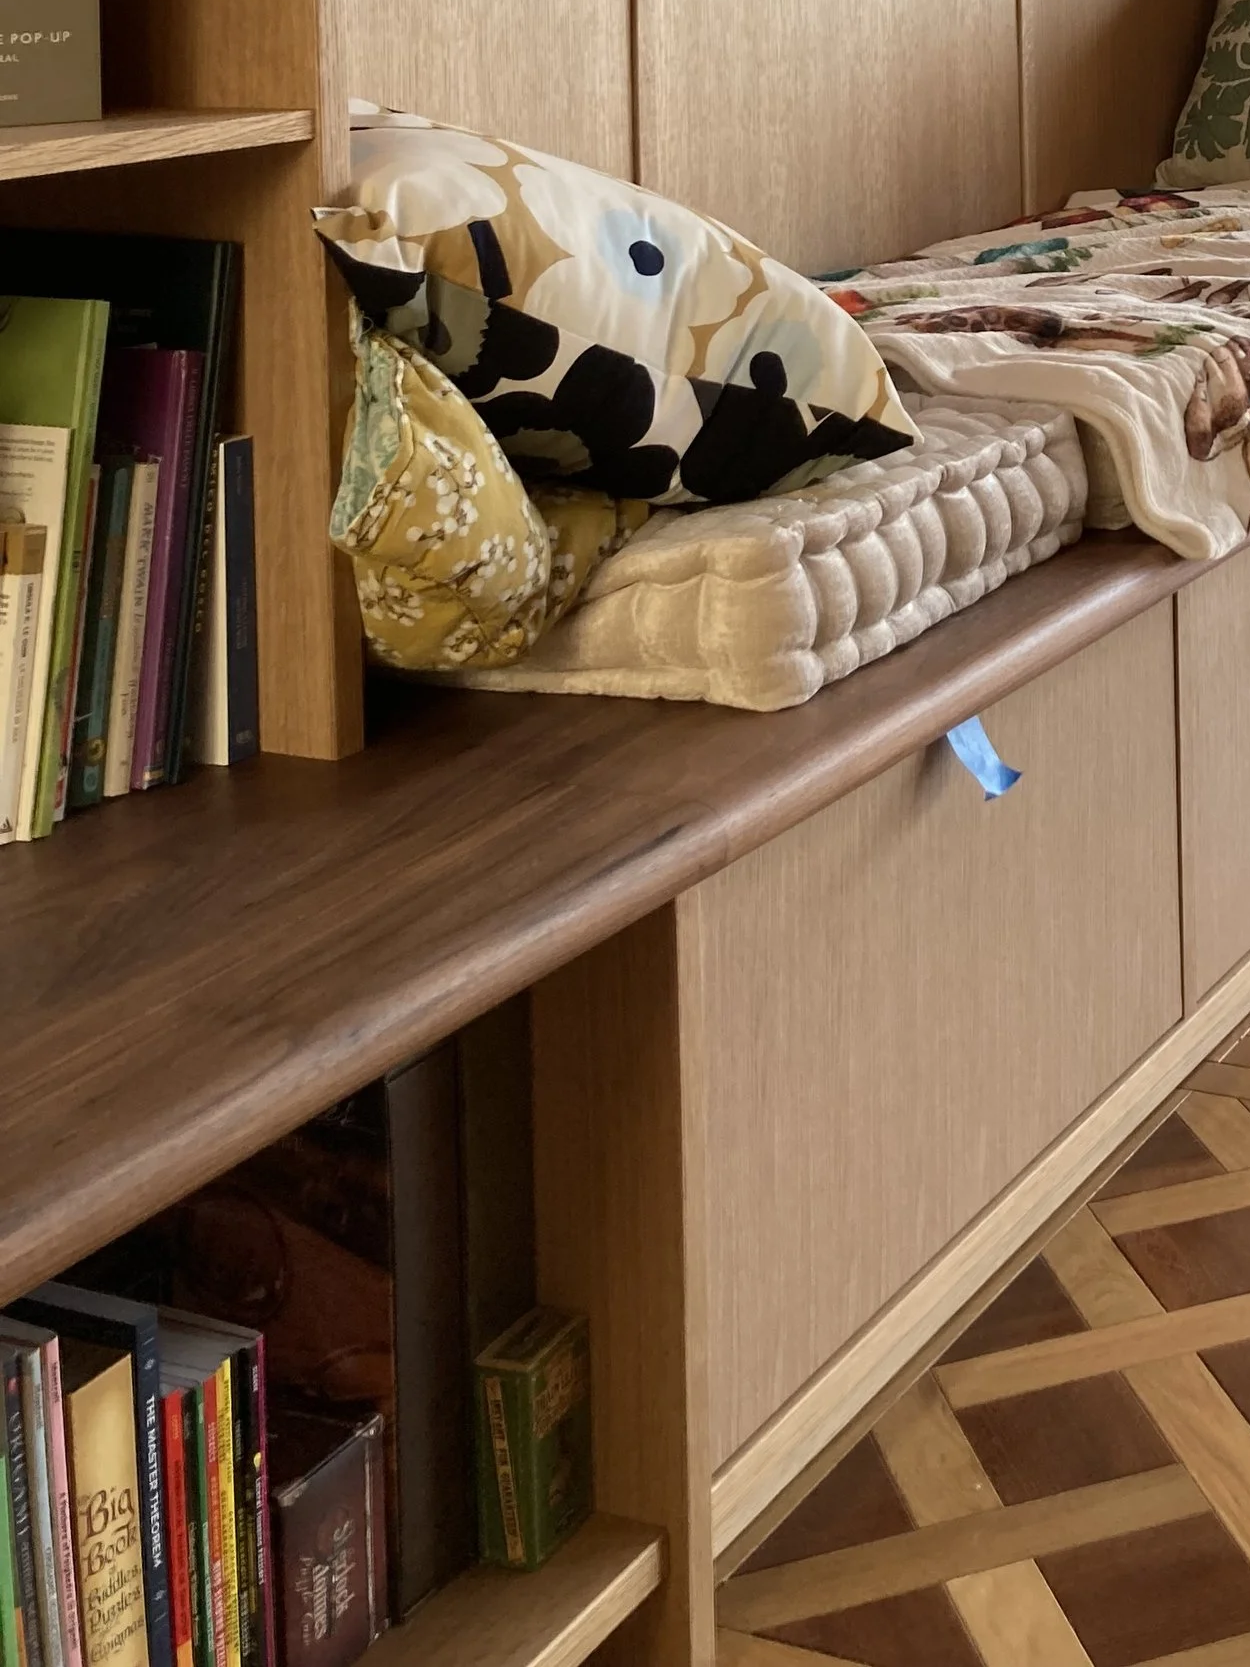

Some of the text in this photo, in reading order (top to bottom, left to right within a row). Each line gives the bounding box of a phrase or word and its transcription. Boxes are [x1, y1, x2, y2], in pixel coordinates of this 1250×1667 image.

[10, 30, 71, 45] POP-UP
[133, 501, 155, 608] MARK TWAIN
[8, 1411, 31, 1537] ORIGAMI
[79, 1486, 135, 1545] Big
[145, 1395, 164, 1570] THE MASTER THEOREM
[80, 1522, 138, 1582] Book
[331, 1517, 357, 1620] Sherlock
[312, 1563, 331, 1641] Holmes
